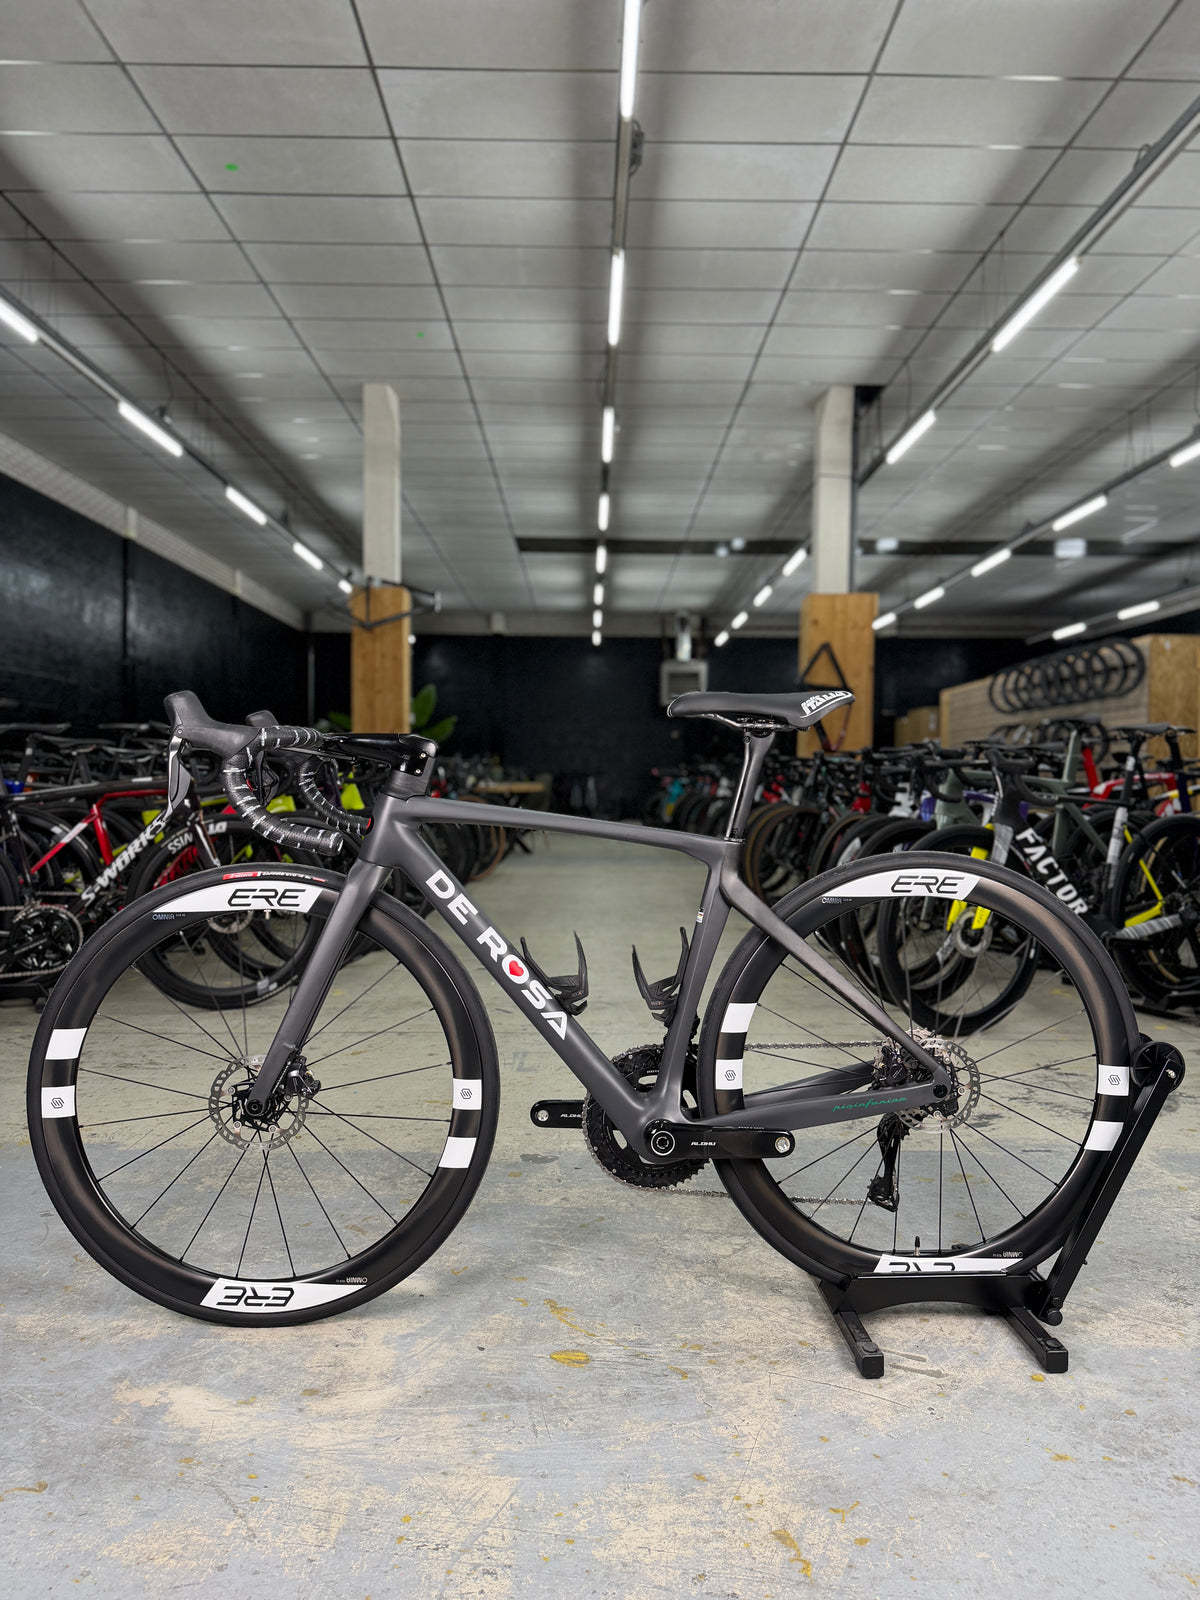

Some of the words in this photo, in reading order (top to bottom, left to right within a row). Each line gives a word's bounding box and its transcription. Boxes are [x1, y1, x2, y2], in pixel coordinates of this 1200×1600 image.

[167, 832, 194, 855] WISS
[1015, 827, 1089, 915] FACTOR
[891, 875, 966, 895] ERE
[227, 888, 307, 907] ERE
[426, 869, 479, 926] DE
[476, 926, 568, 1041] ROSA
[831, 1097, 907, 1112] pininfarina
[216, 1285, 295, 1307] ERE
